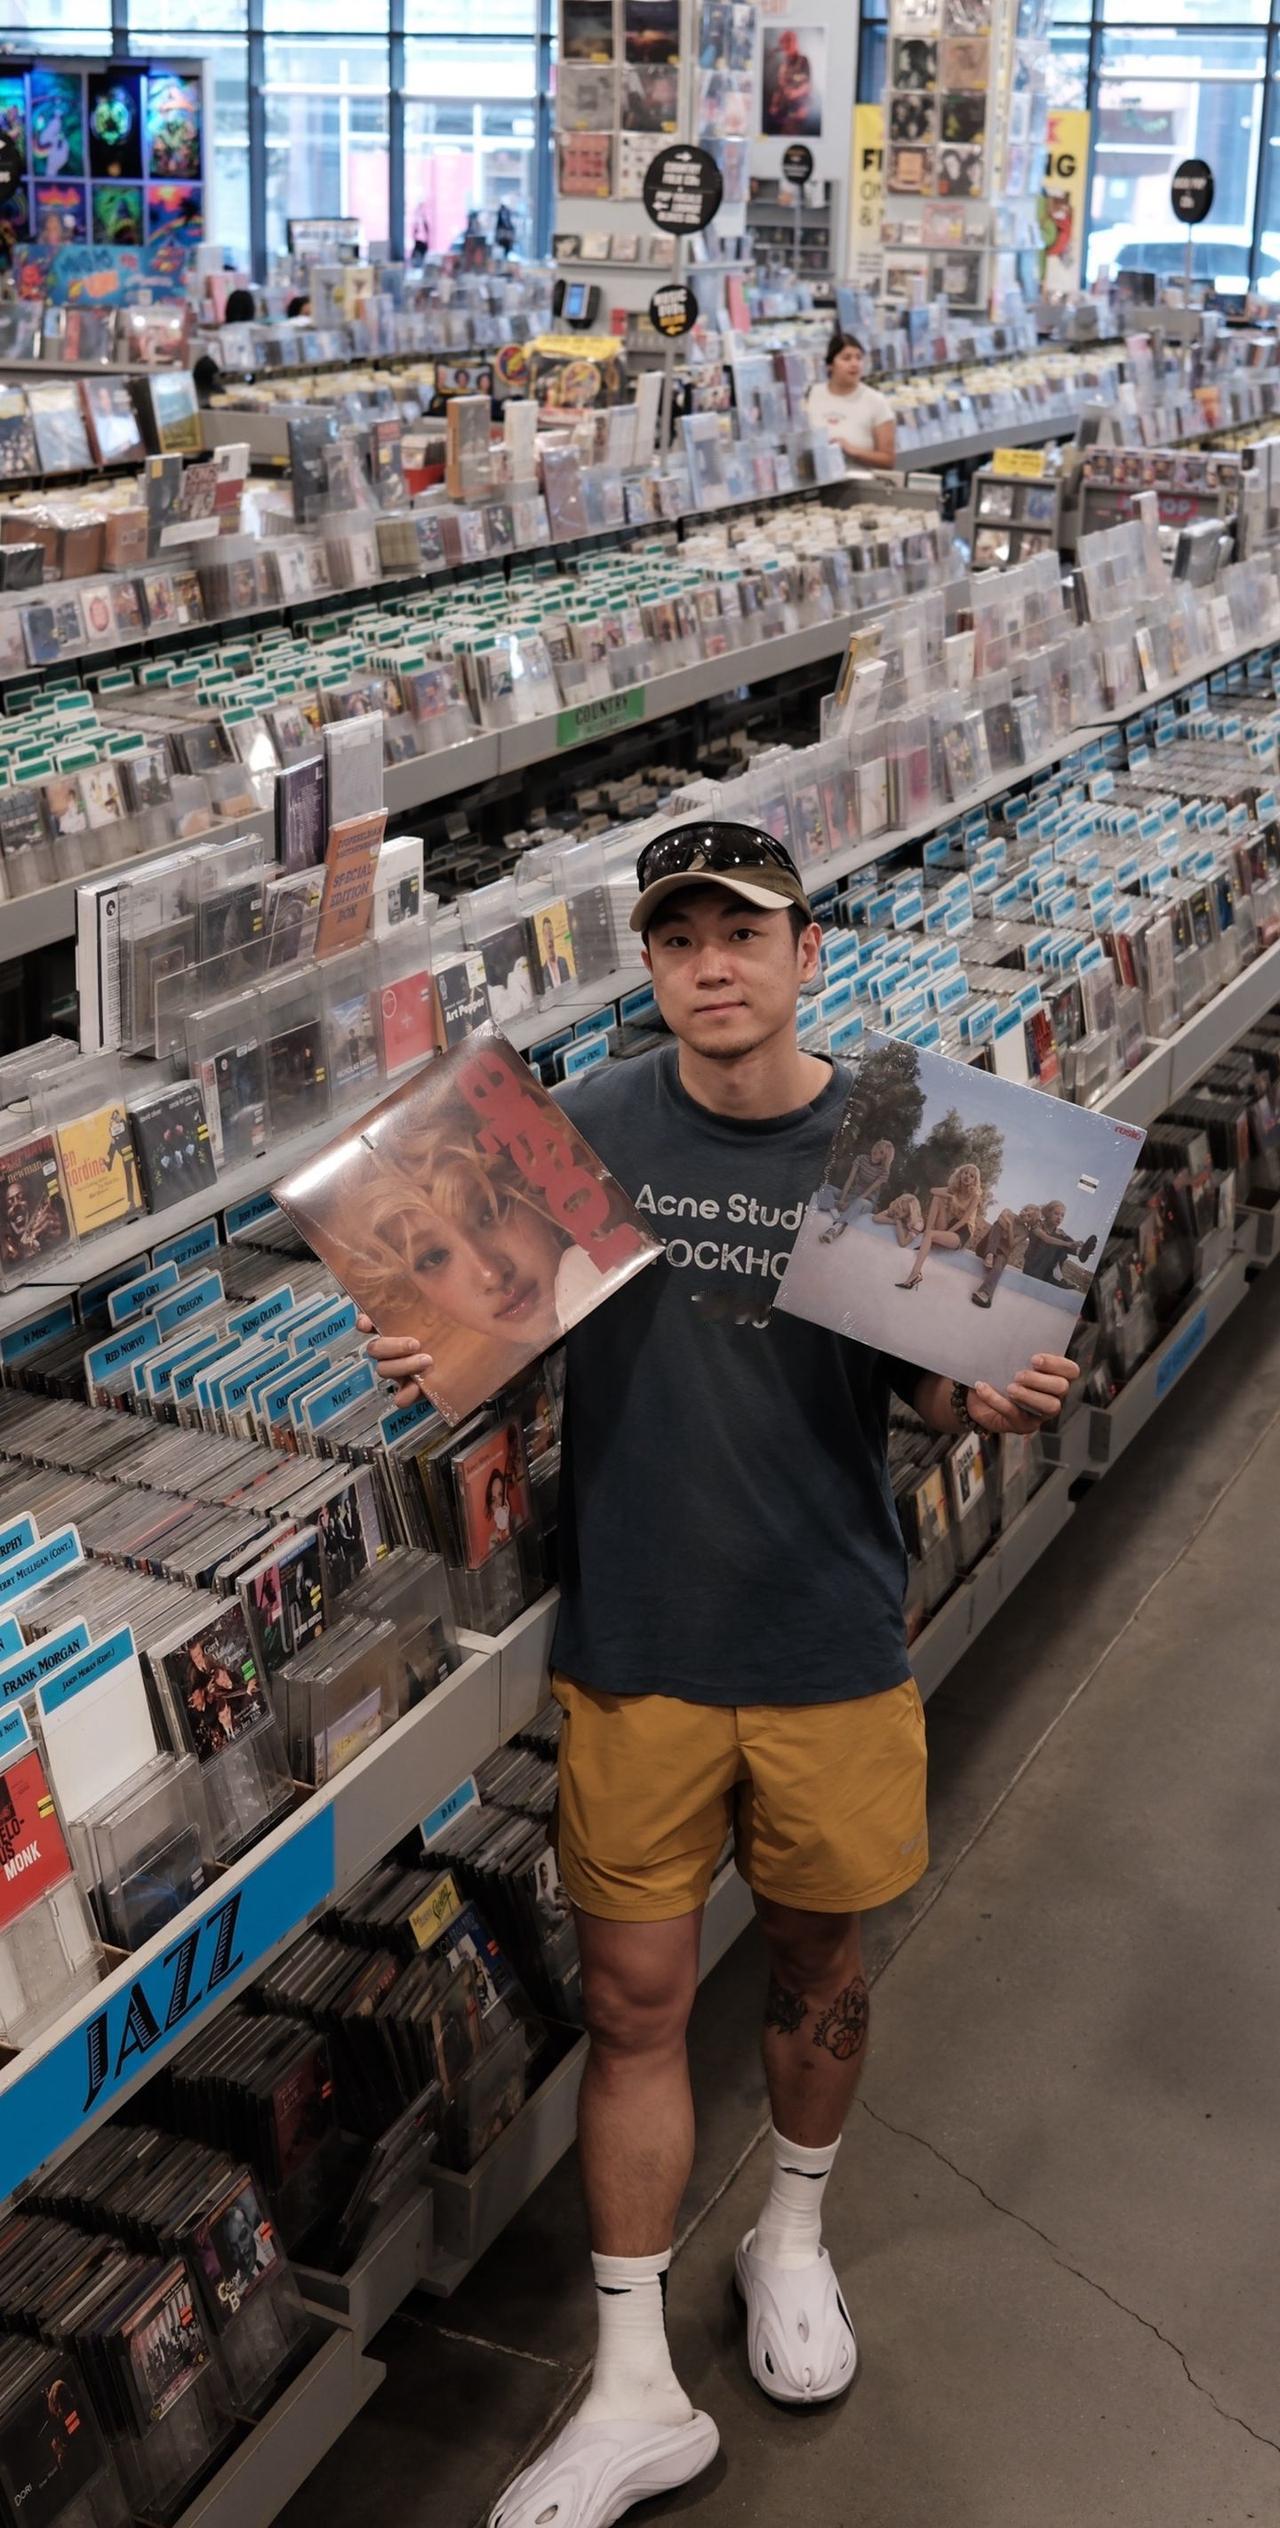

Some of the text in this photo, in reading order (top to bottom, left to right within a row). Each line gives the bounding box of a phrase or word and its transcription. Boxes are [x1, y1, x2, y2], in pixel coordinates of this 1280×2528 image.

[635, 1184, 720, 1221] Acne
[132, 1290, 146, 1305] KID
[145, 1282, 161, 1299] ORY
[177, 1294, 204, 1317] OREGON
[242, 1302, 283, 1334] KING OLIVER
[104, 1334, 146, 1366] RED NORVO
[308, 1330, 328, 1349] ANITA
[16, 1555, 50, 1582] MULLIGAN
[50, 1538, 75, 1562] (CONT.)
[3, 1638, 82, 1697] FRANK MORGAN
[3, 1840, 42, 1882] MONK
[82, 1891, 244, 2112] JAZZ
